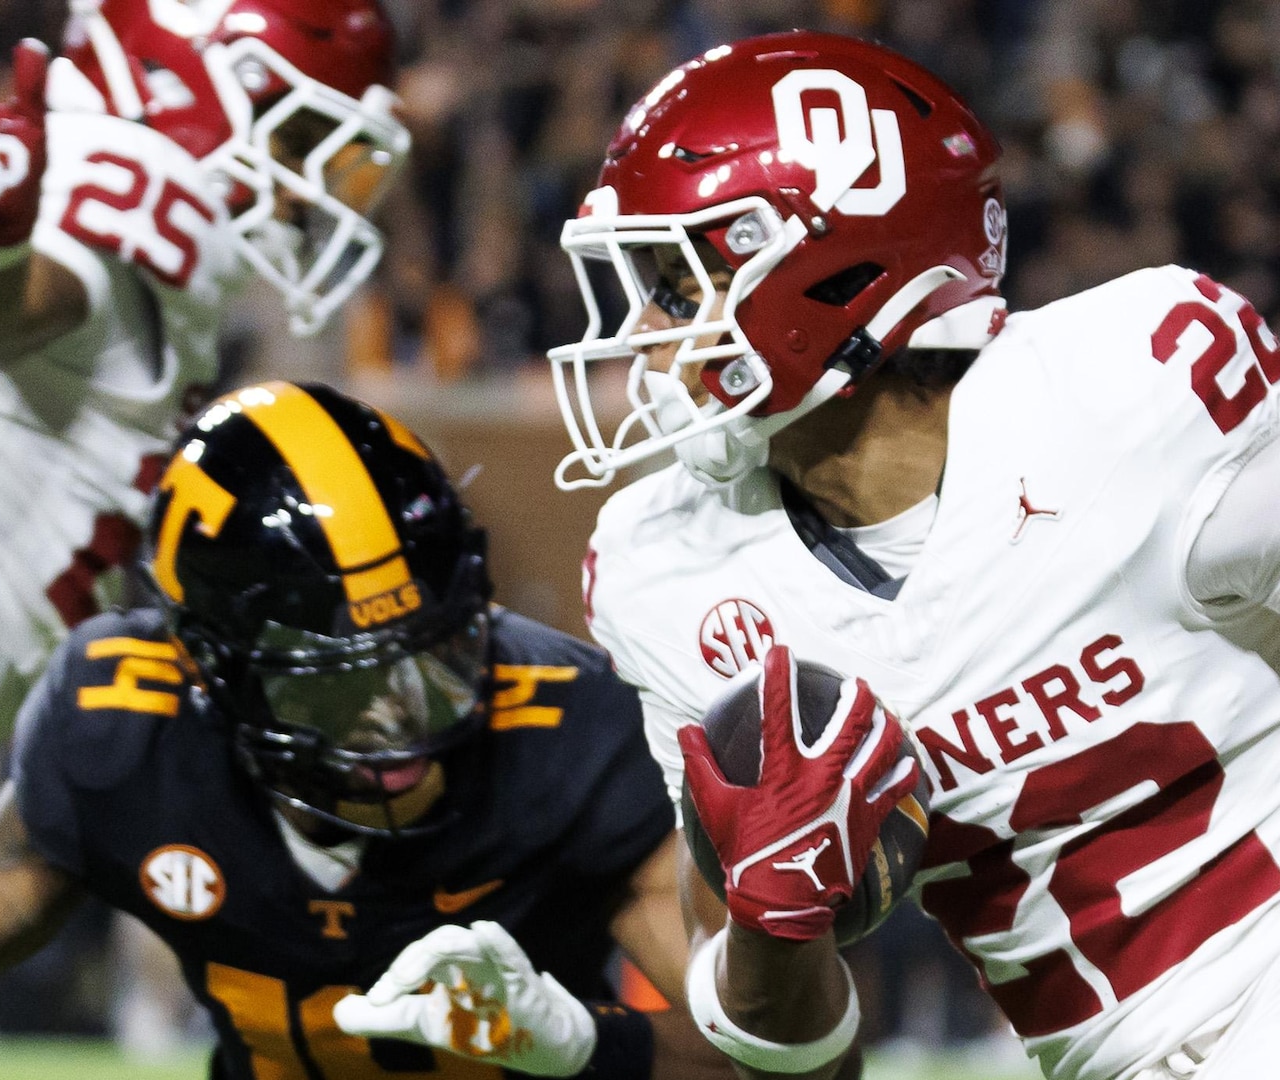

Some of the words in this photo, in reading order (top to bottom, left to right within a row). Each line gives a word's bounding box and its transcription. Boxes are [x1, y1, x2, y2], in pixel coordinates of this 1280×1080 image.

[771, 68, 907, 217] OU
[59, 151, 215, 288] 25
[152, 447, 237, 603] T
[699, 598, 774, 680] SEC
[916, 634, 1145, 796] NERS
[307, 900, 357, 940] T
